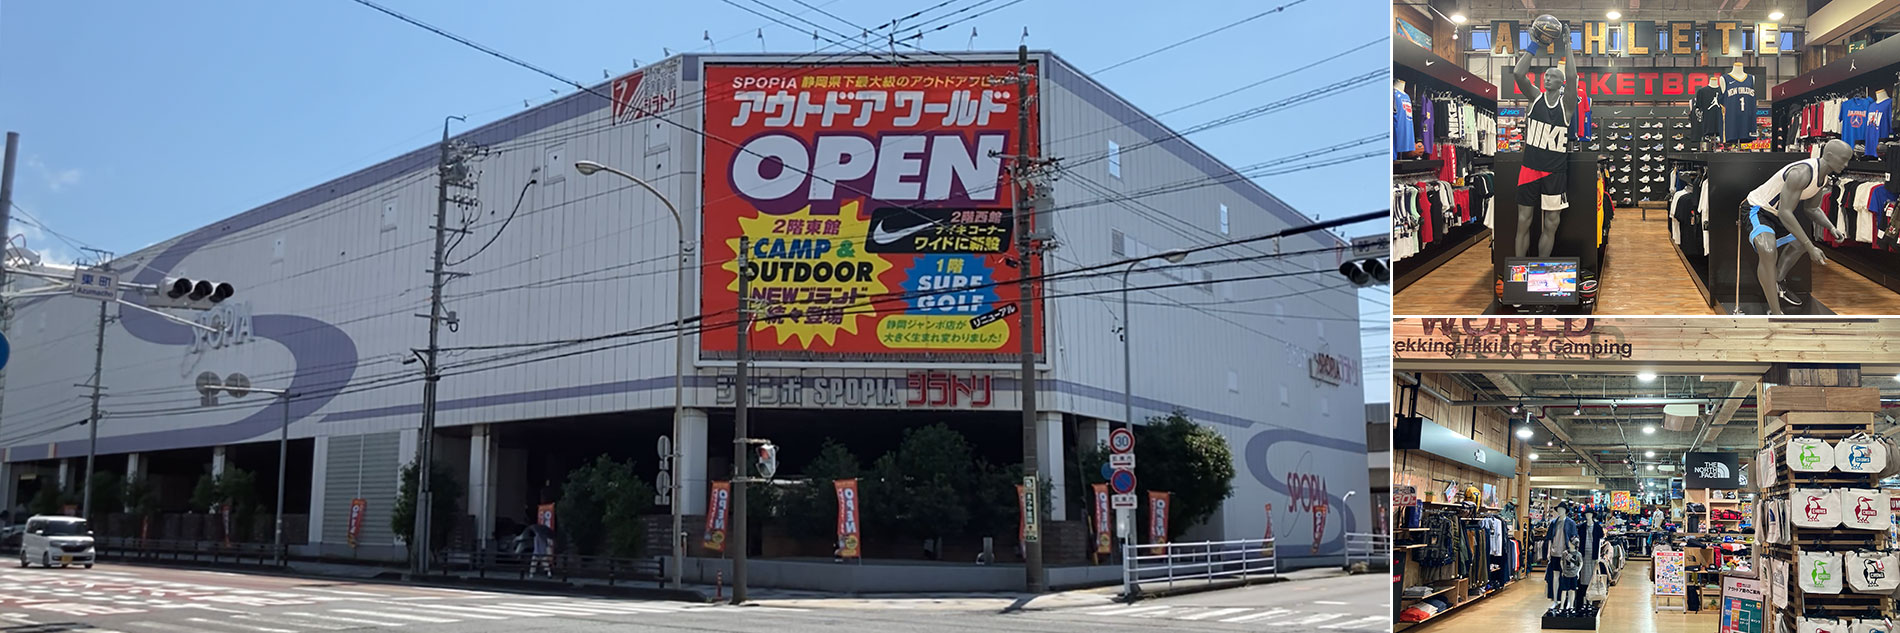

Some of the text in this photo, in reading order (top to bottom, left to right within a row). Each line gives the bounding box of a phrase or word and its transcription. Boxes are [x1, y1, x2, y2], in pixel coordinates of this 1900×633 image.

[1494, 21, 1780, 54] AHLETE
[731, 89, 1010, 127] アウトドア ワールド
[1527, 117, 1568, 153] NIKE
[731, 134, 1005, 201] OPEN
[950, 210, 1002, 224] 2階西館
[772, 218, 841, 236] 2階東館
[753, 237, 856, 260] CAMP &
[914, 237, 1001, 251] ワイドに新設
[936, 258, 965, 274] 1階
[76, 287, 114, 298] Azumacho
[917, 275, 984, 294] SURF
[917, 294, 985, 312] GOLF
[886, 319, 967, 331] 静岡ジャンボ店が
[972, 304, 1016, 328] リニューアル
[883, 332, 1002, 344] 大きく生まれ変わりました!
[1528, 339, 1541, 354] &
[1549, 339, 1633, 359] Camping
[813, 377, 902, 407] SPOPIA
[906, 373, 992, 407] シラトリ
[1114, 435, 1129, 448] 30
[1694, 466, 1718, 474] NORTH
[1287, 471, 1331, 514] SPOPIA
